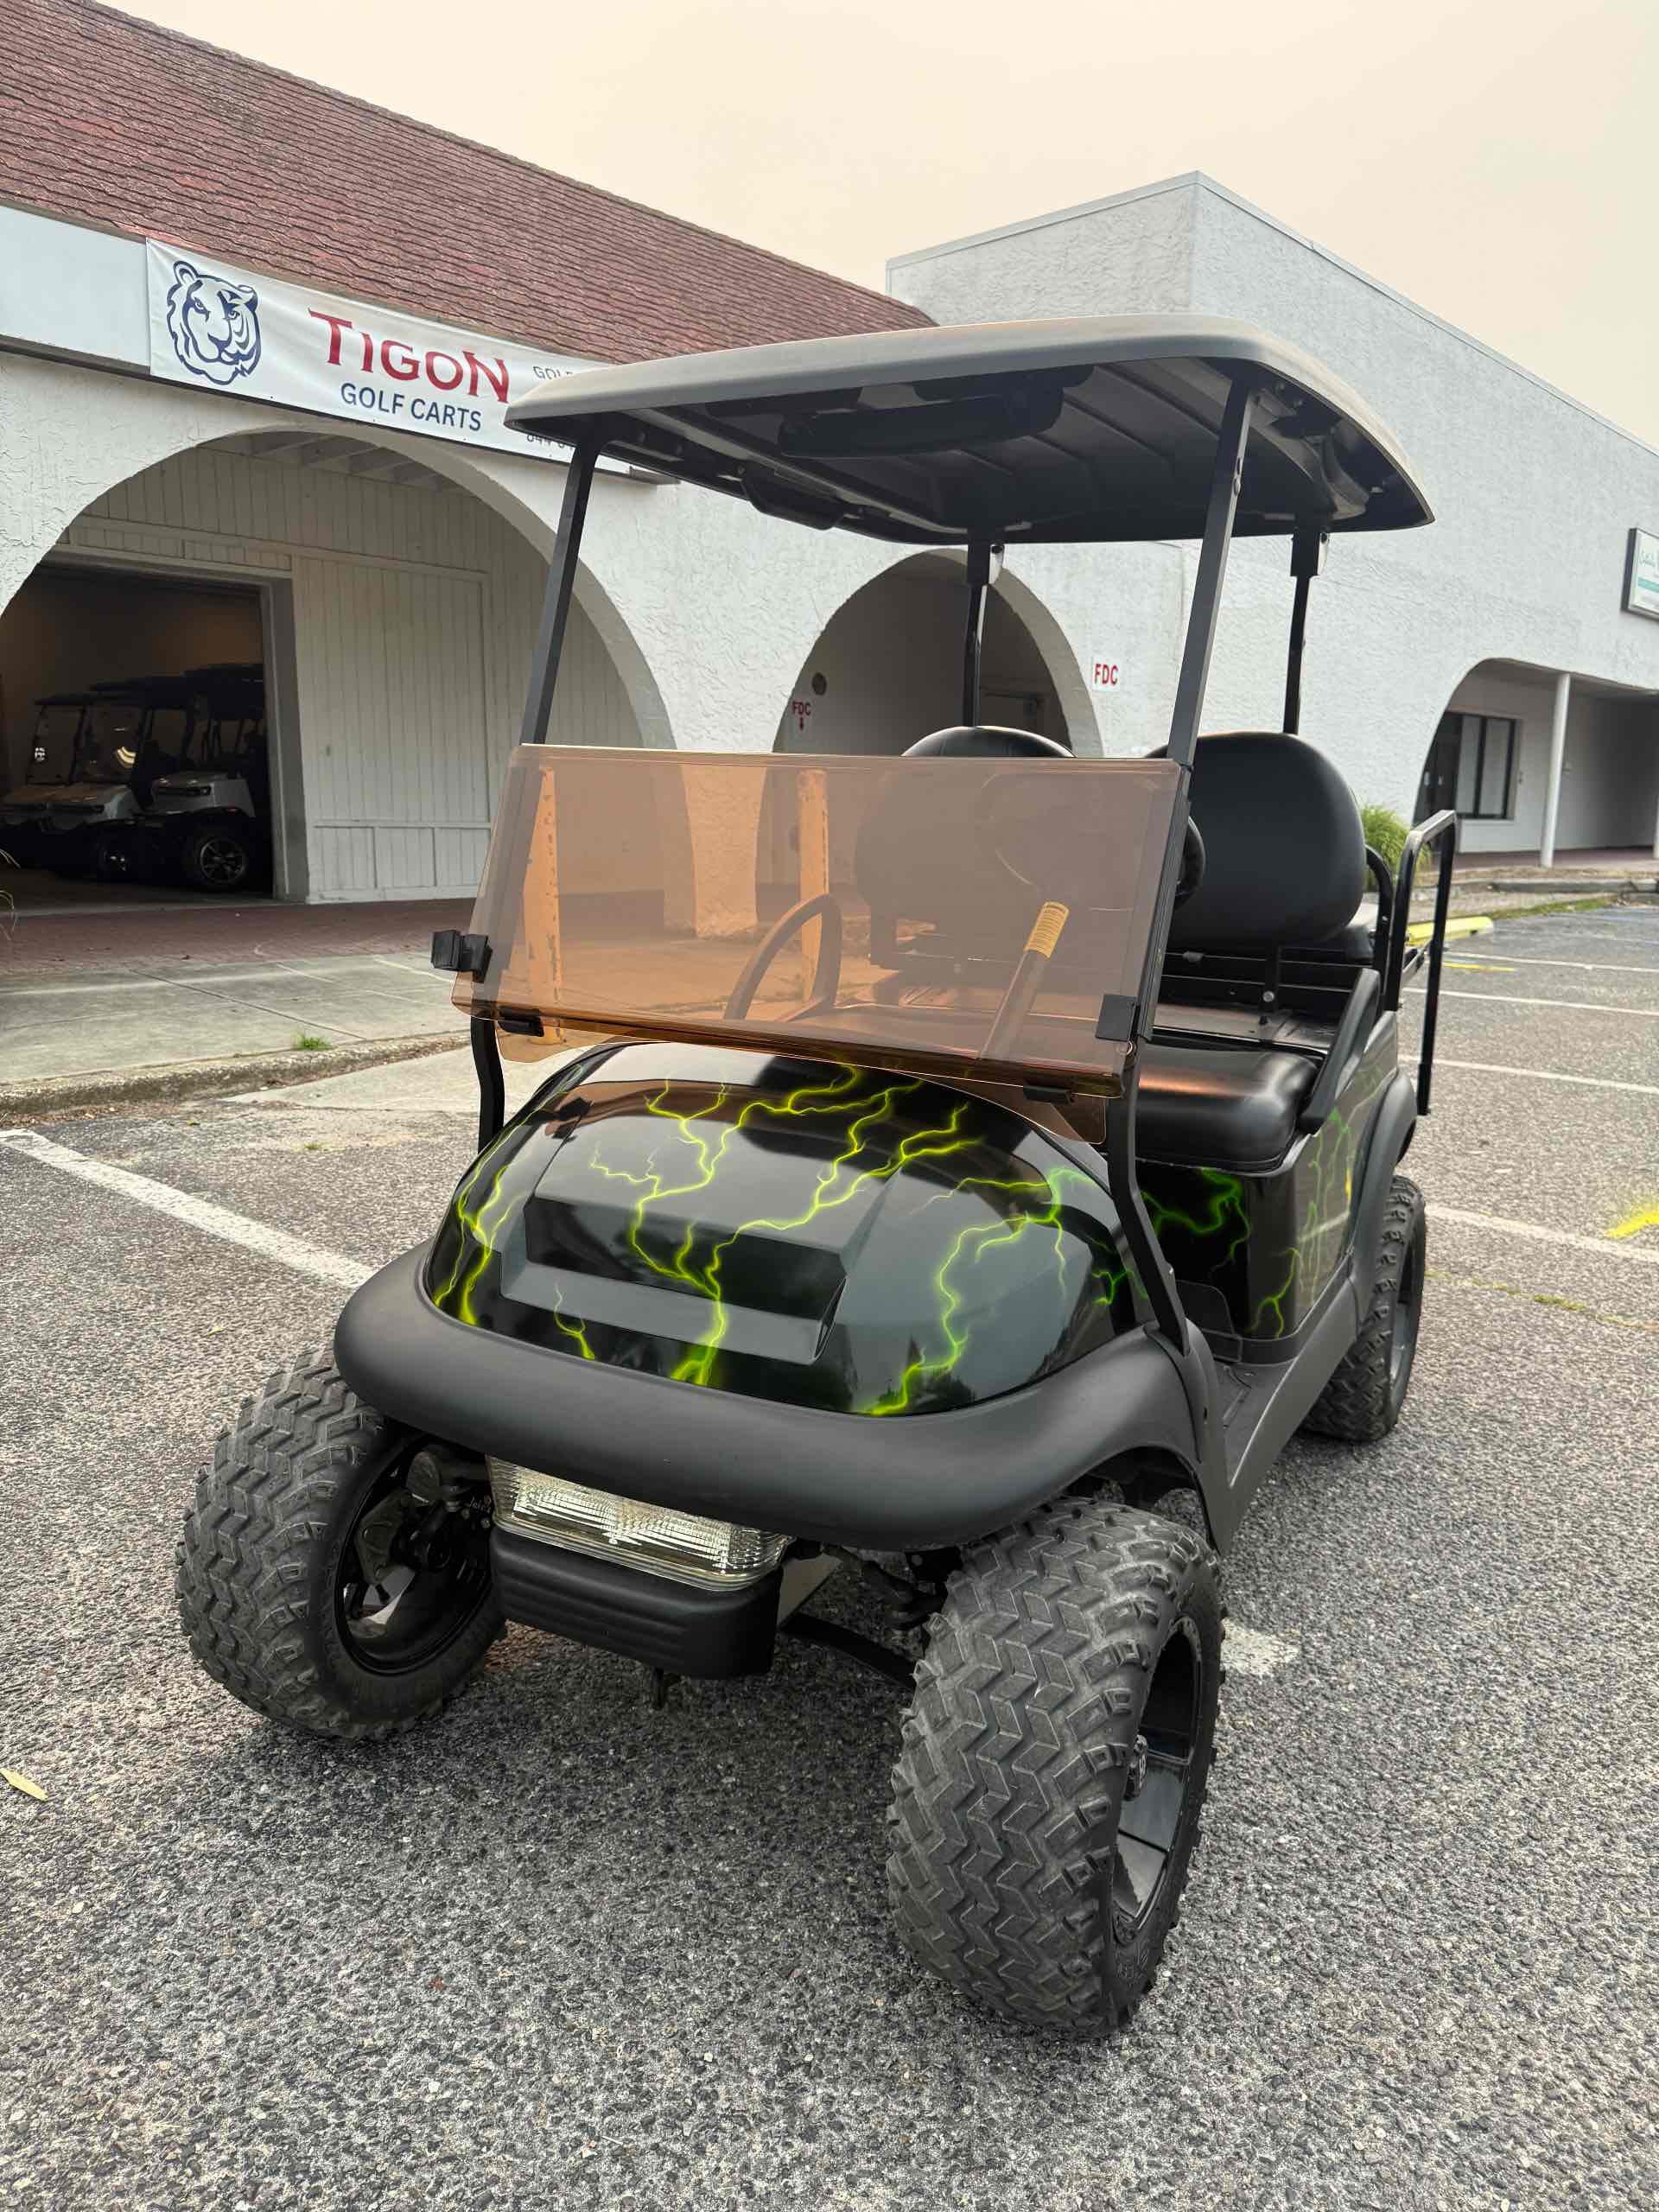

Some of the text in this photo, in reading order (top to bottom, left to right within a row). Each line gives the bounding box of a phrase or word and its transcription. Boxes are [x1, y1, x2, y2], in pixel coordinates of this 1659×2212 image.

[308, 308, 509, 404] TIGON
[532, 365, 574, 380] GO
[340, 383, 482, 431] GOLF CARTS
[1094, 663, 1119, 685] FDC
[791, 700, 811, 716] FDC
